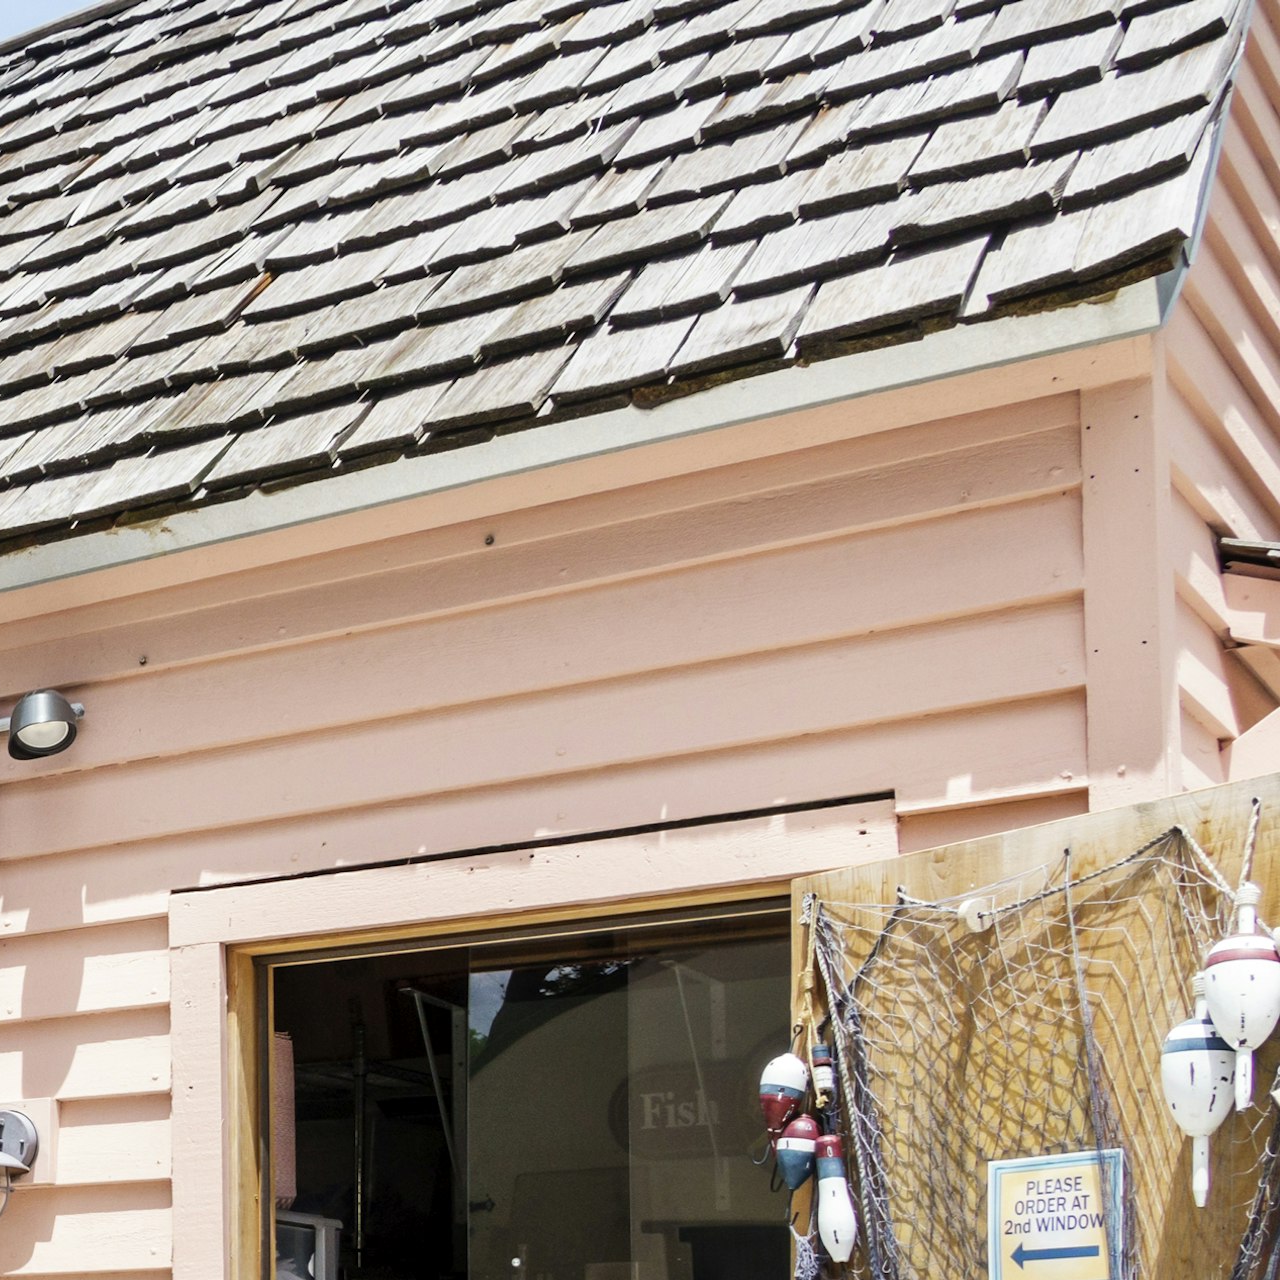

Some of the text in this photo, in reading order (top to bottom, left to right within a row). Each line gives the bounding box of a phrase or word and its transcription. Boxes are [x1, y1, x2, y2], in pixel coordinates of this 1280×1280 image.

[640, 1089, 719, 1130] Fish
[1026, 1176, 1083, 1196] PLEASE
[1014, 1195, 1090, 1216] ORDER AT
[1004, 1212, 1105, 1235] 2nd WINDOW
